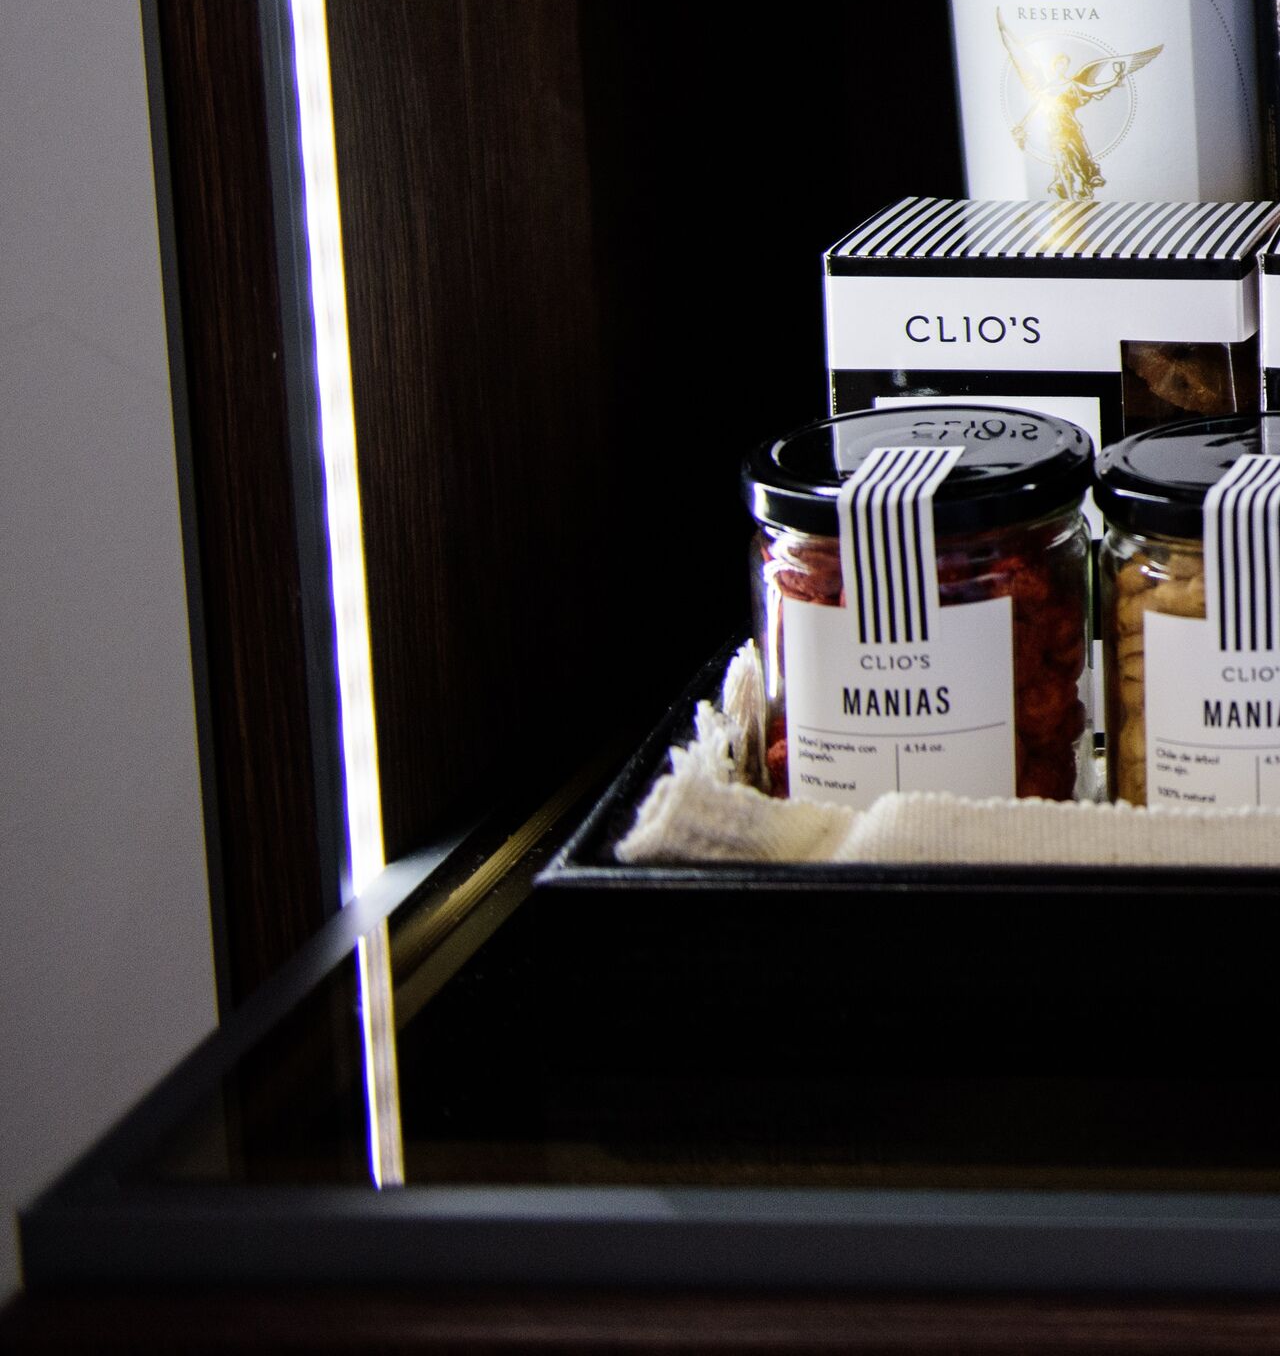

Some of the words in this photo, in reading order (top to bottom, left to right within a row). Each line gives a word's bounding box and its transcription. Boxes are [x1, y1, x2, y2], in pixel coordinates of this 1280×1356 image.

[1017, 7, 1101, 21] RESERVA
[905, 315, 1041, 344] CLIO'S
[860, 654, 931, 671] CLIO'S
[842, 687, 951, 717] MANIAS
